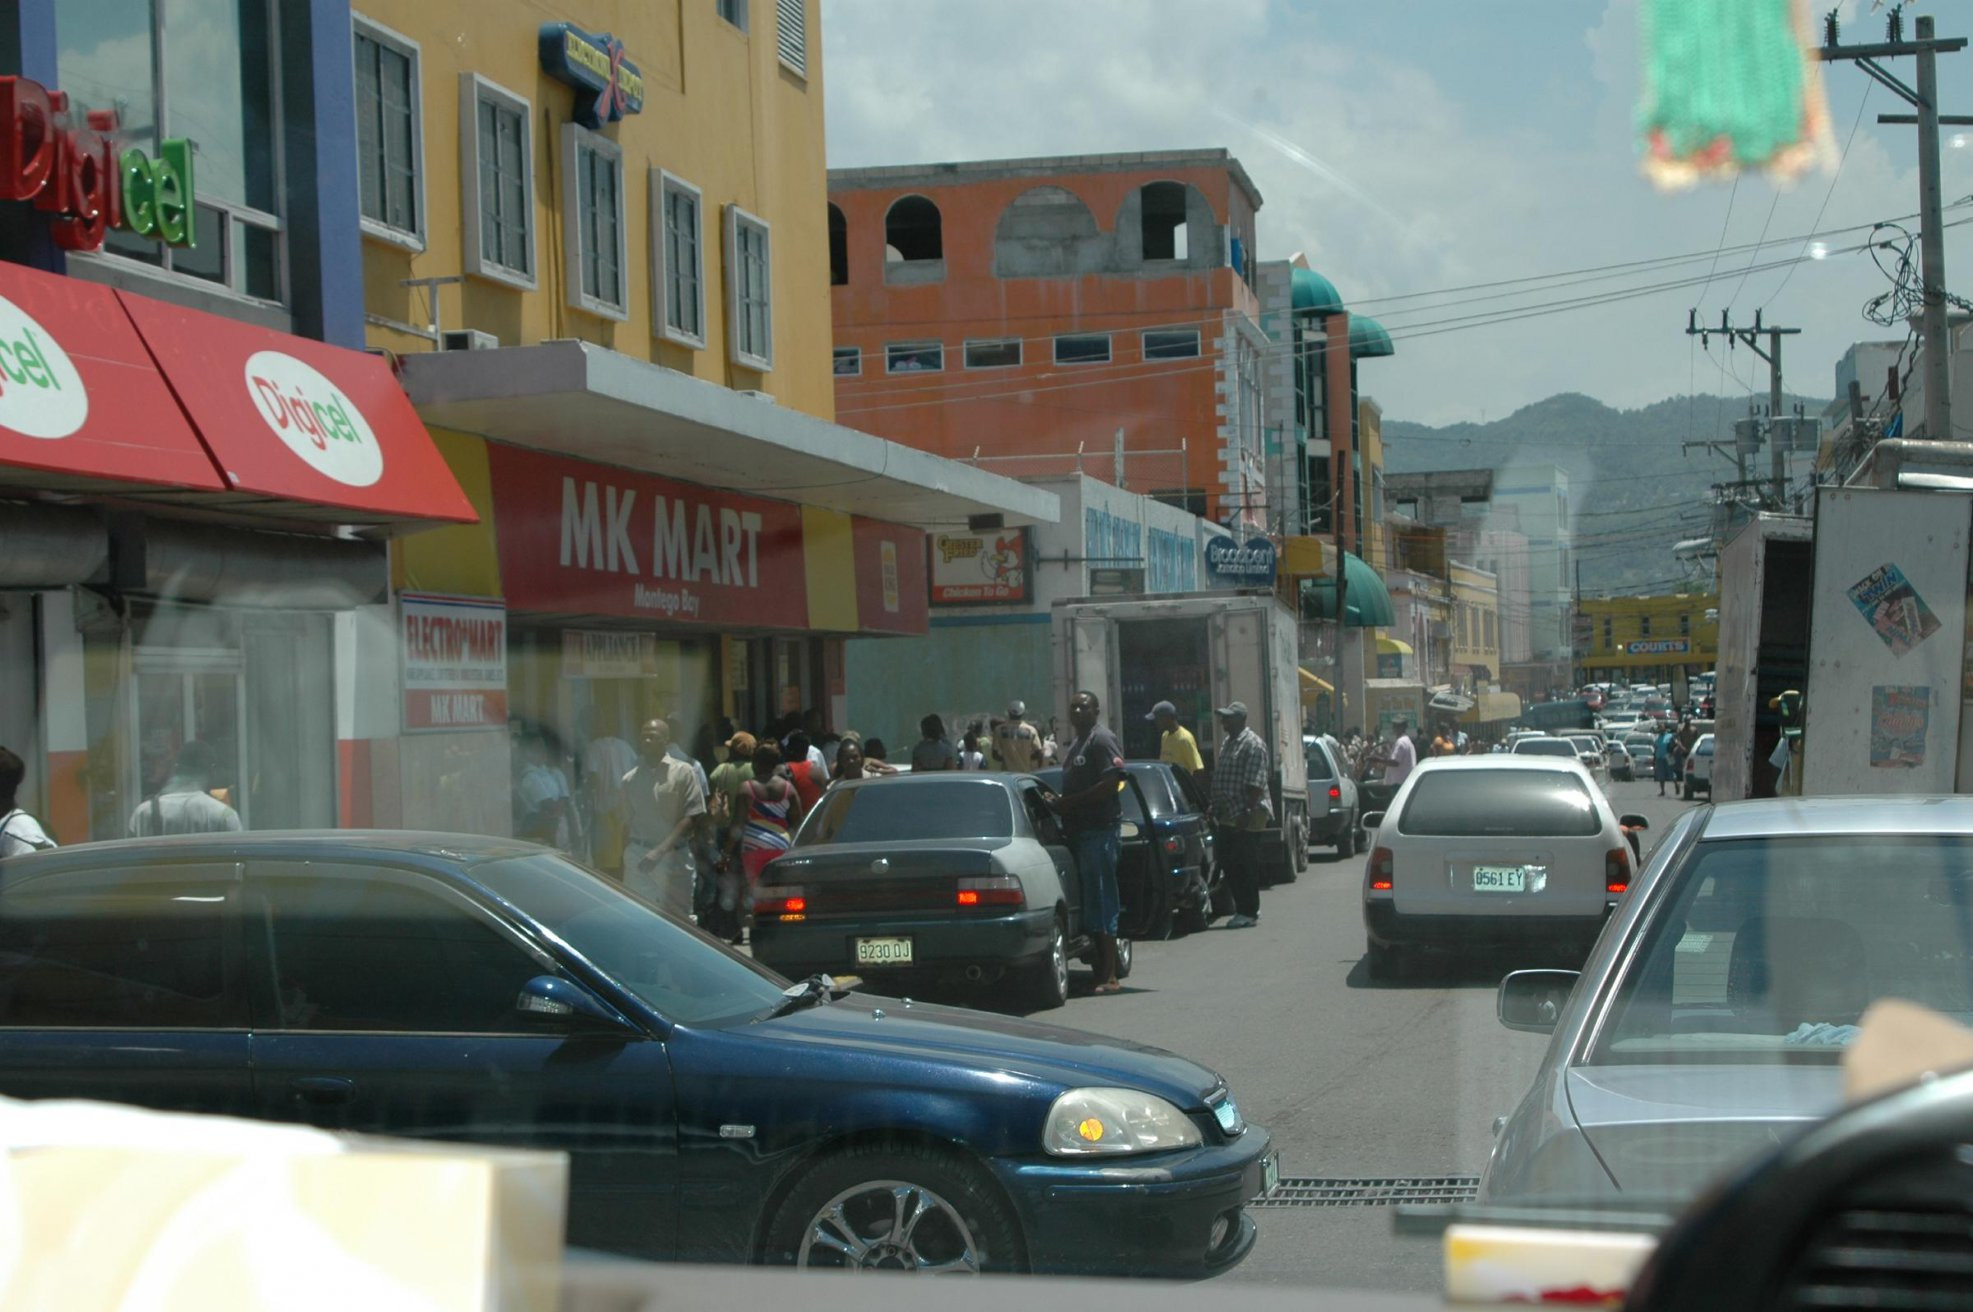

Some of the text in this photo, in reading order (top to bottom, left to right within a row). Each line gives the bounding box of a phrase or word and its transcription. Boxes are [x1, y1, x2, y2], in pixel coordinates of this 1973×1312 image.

[0, 75, 196, 252] Digicel
[251, 375, 362, 451] Digicel
[560, 476, 763, 588] MK MART
[633, 582, 700, 618] Montego Bay
[1630, 641, 1685, 653] COURTS
[430, 694, 484, 724] MK MART
[1507, 872, 1523, 886] EY
[859, 944, 891, 959] 9230
